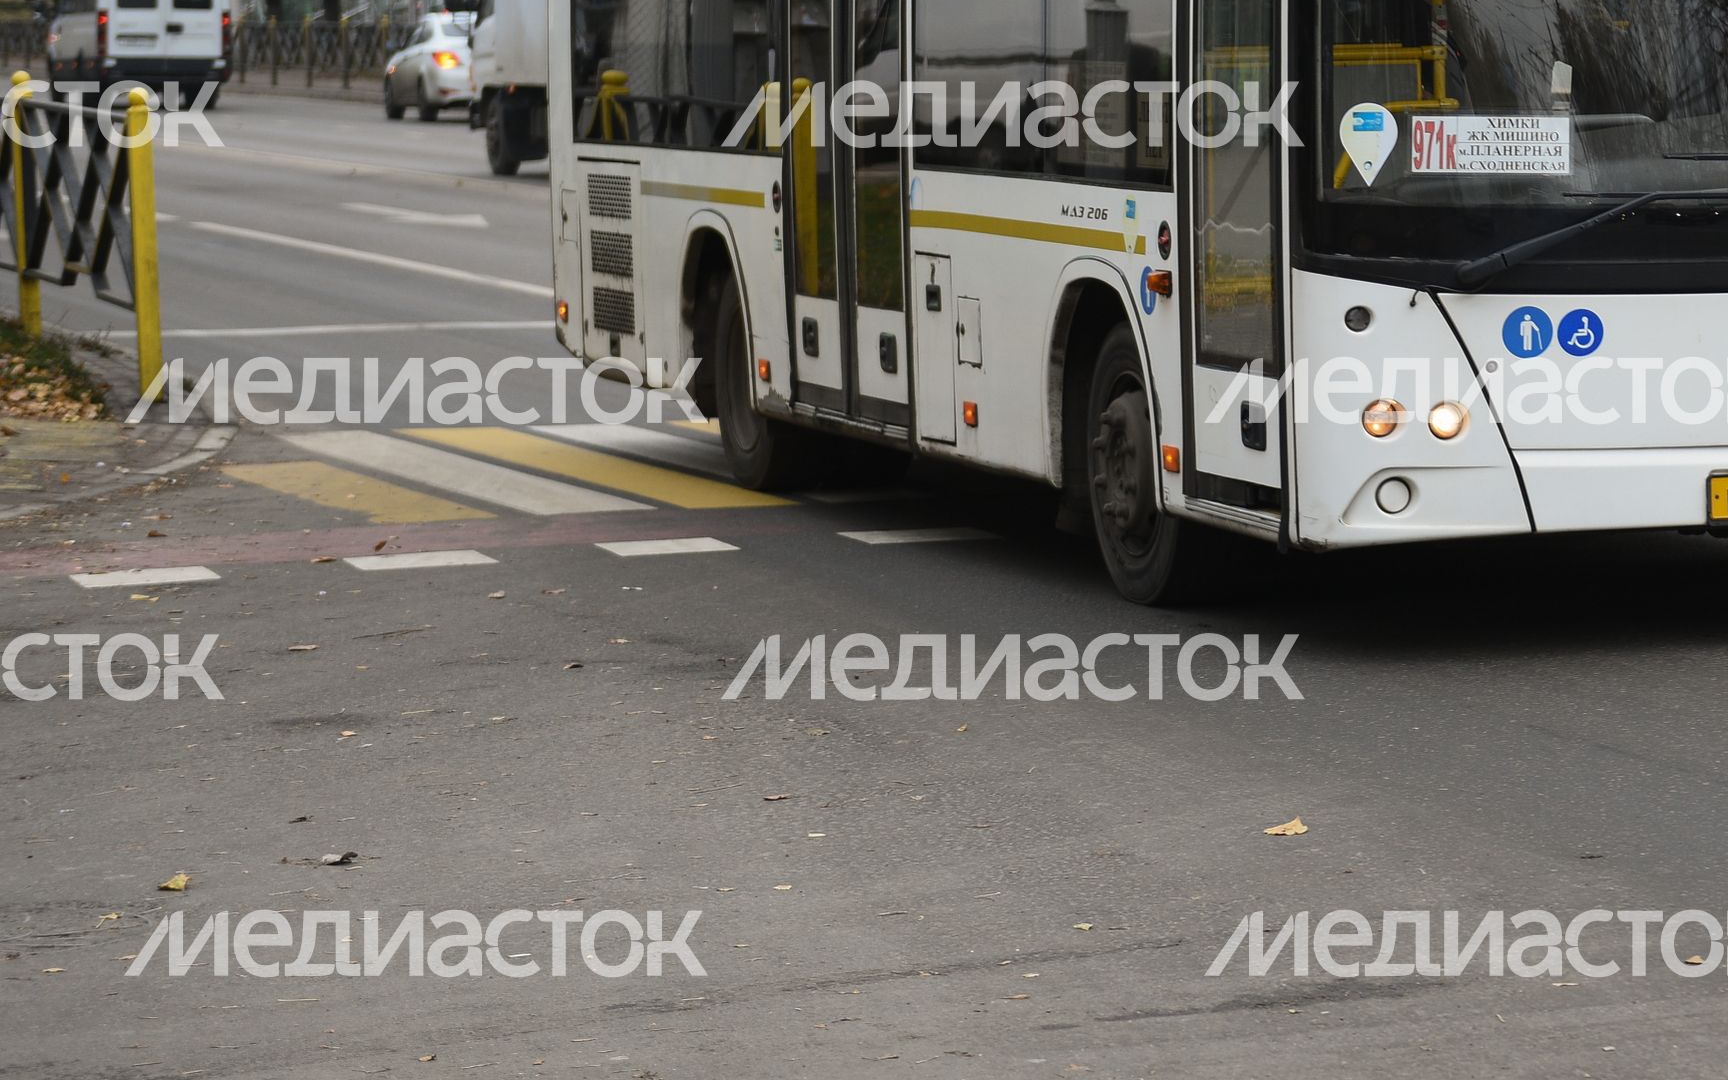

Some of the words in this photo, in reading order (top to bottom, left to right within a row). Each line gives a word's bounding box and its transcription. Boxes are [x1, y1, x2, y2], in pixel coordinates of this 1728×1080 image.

[1487, 118, 1540, 129] ХИМКИ
[1467, 131, 1489, 141] ЖК
[1493, 131, 1560, 142] МИШИНО
[1060, 204, 1084, 218] МАЗ
[1087, 207, 1109, 220] 206
